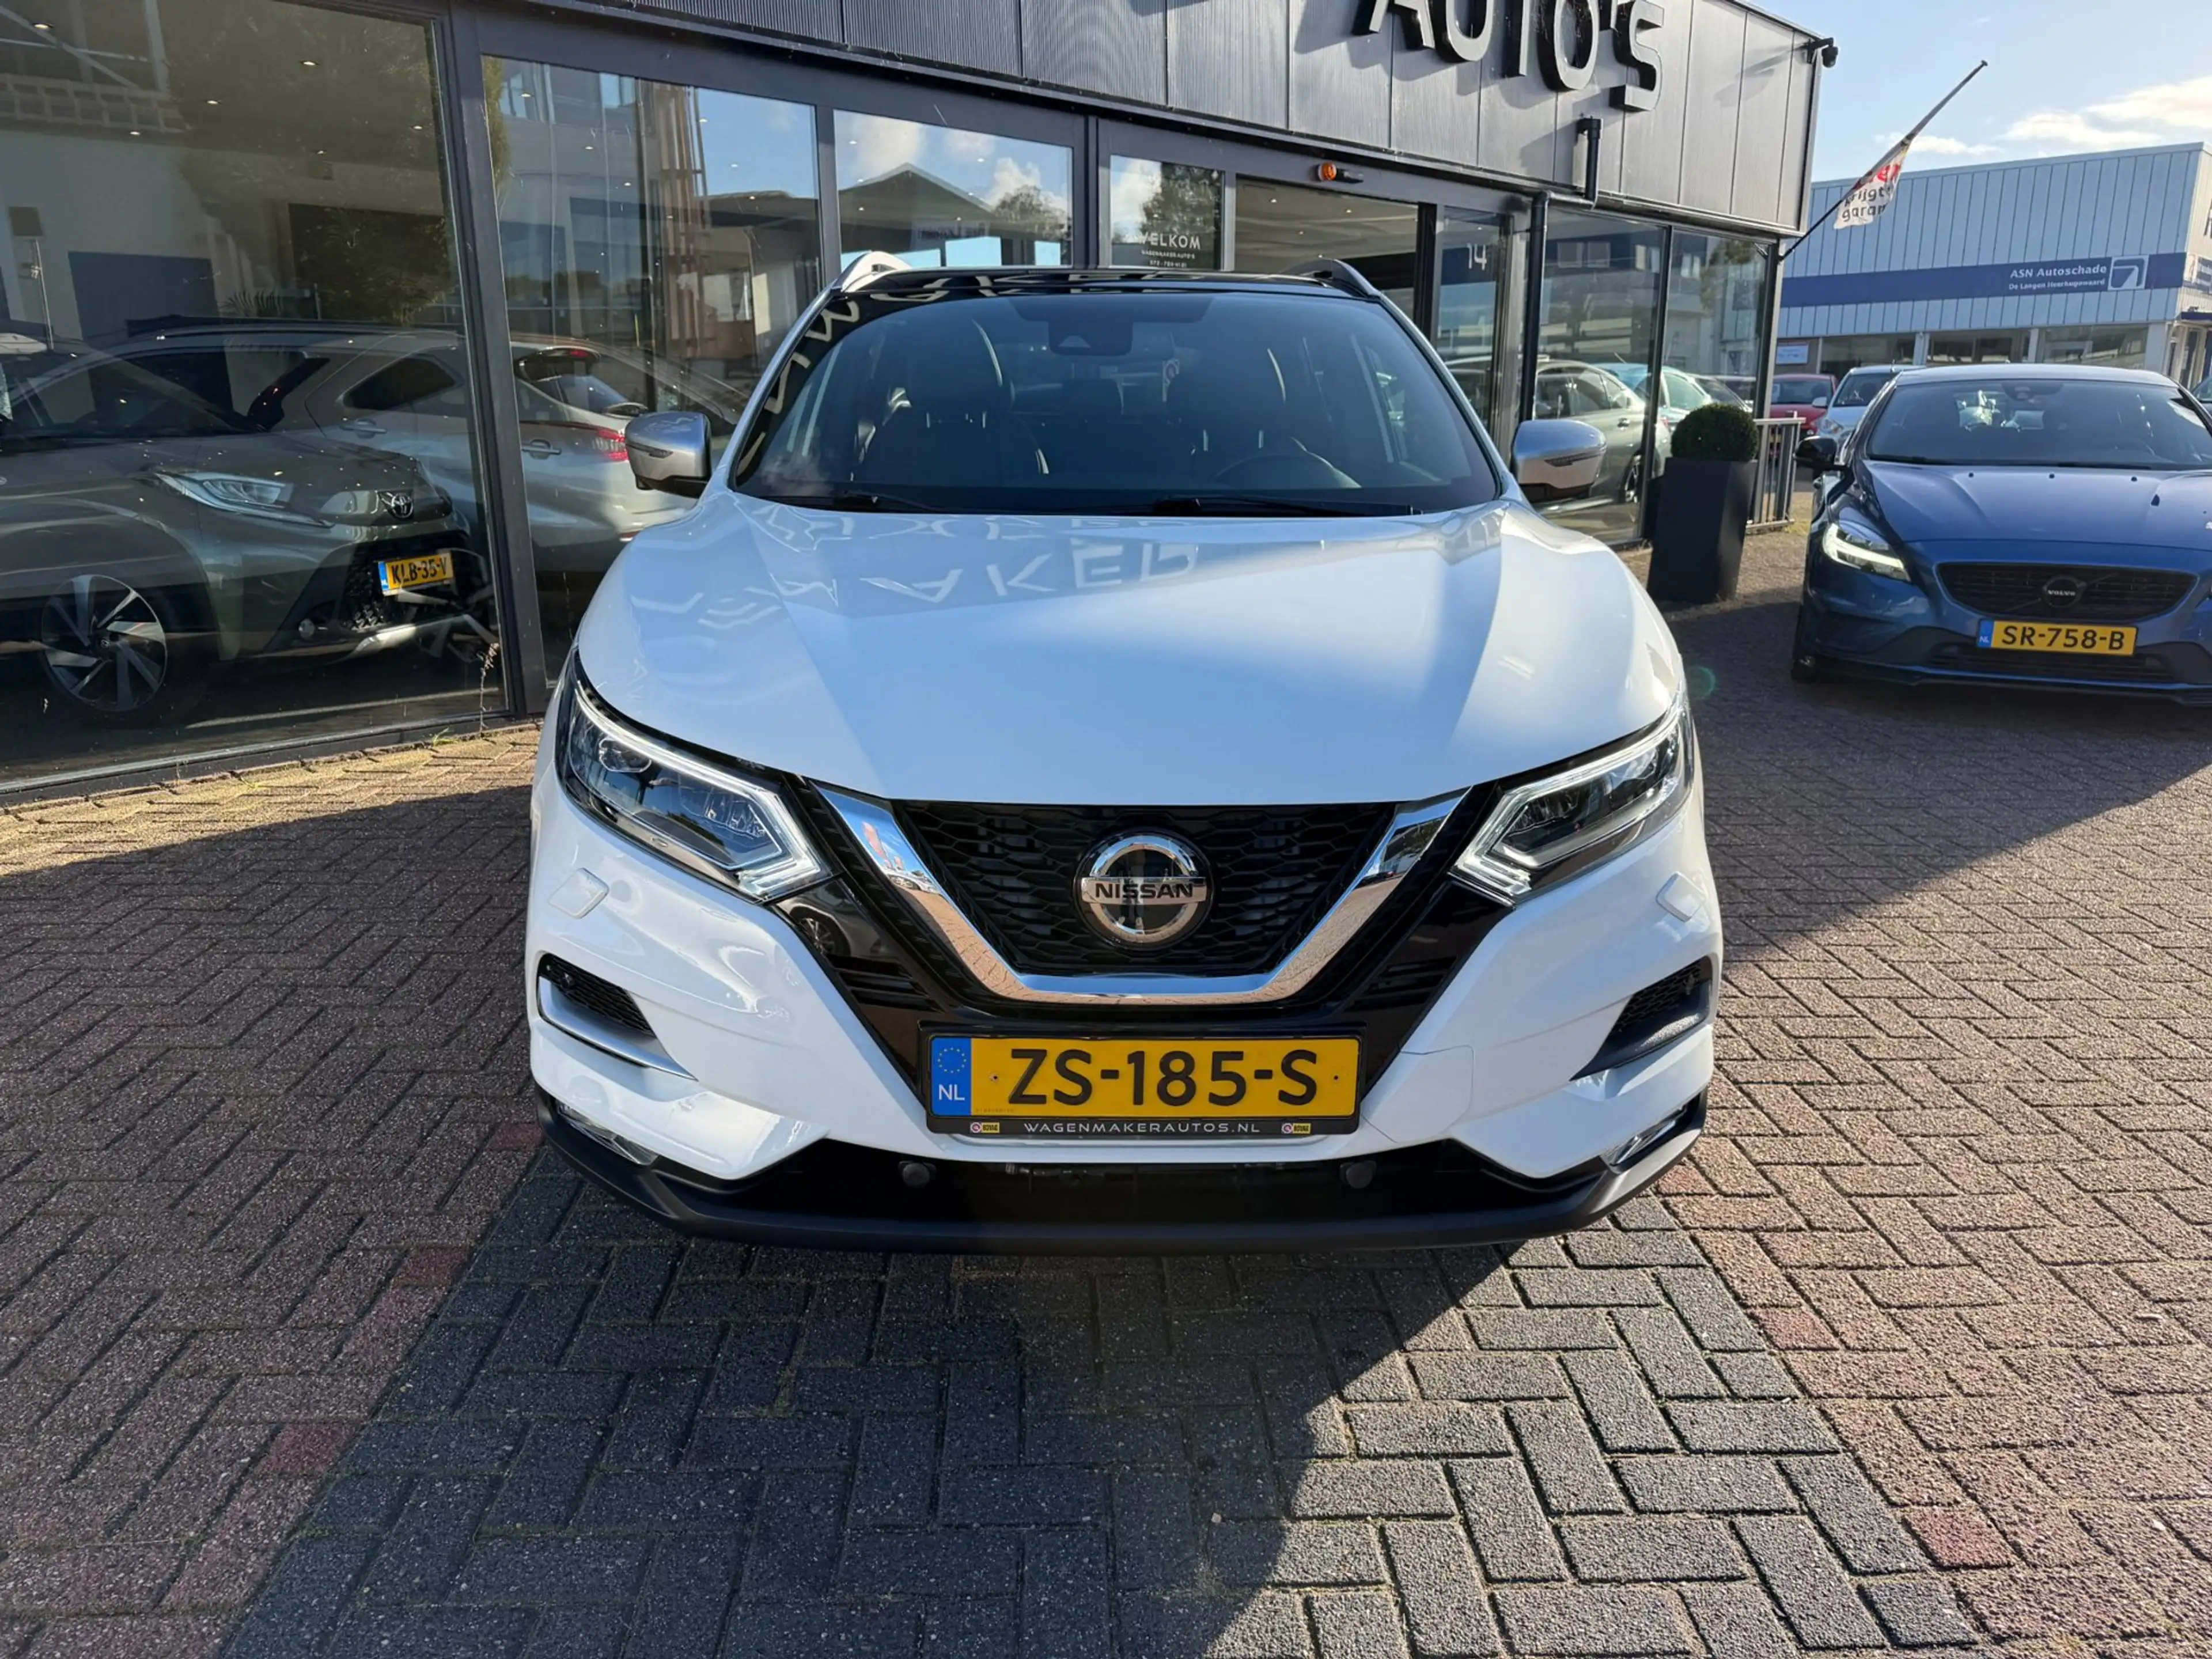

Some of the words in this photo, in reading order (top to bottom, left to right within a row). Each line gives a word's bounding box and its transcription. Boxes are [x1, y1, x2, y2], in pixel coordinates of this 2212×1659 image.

[1138, 232, 1200, 249] WELKOM
[1467, 243, 1487, 271] 14
[2010, 268, 2033, 278] ASN
[2037, 264, 2107, 277] Autoschade
[392, 556, 447, 584] KLB-35-V
[2002, 625, 2125, 650] SR-758-B
[1096, 883, 1193, 899] NISSAN
[938, 1084, 965, 1101] NL
[1009, 1048, 1317, 1106] ZS-185-S
[1023, 1123, 1260, 1133] WAGENMAKERAUTOS.NL
